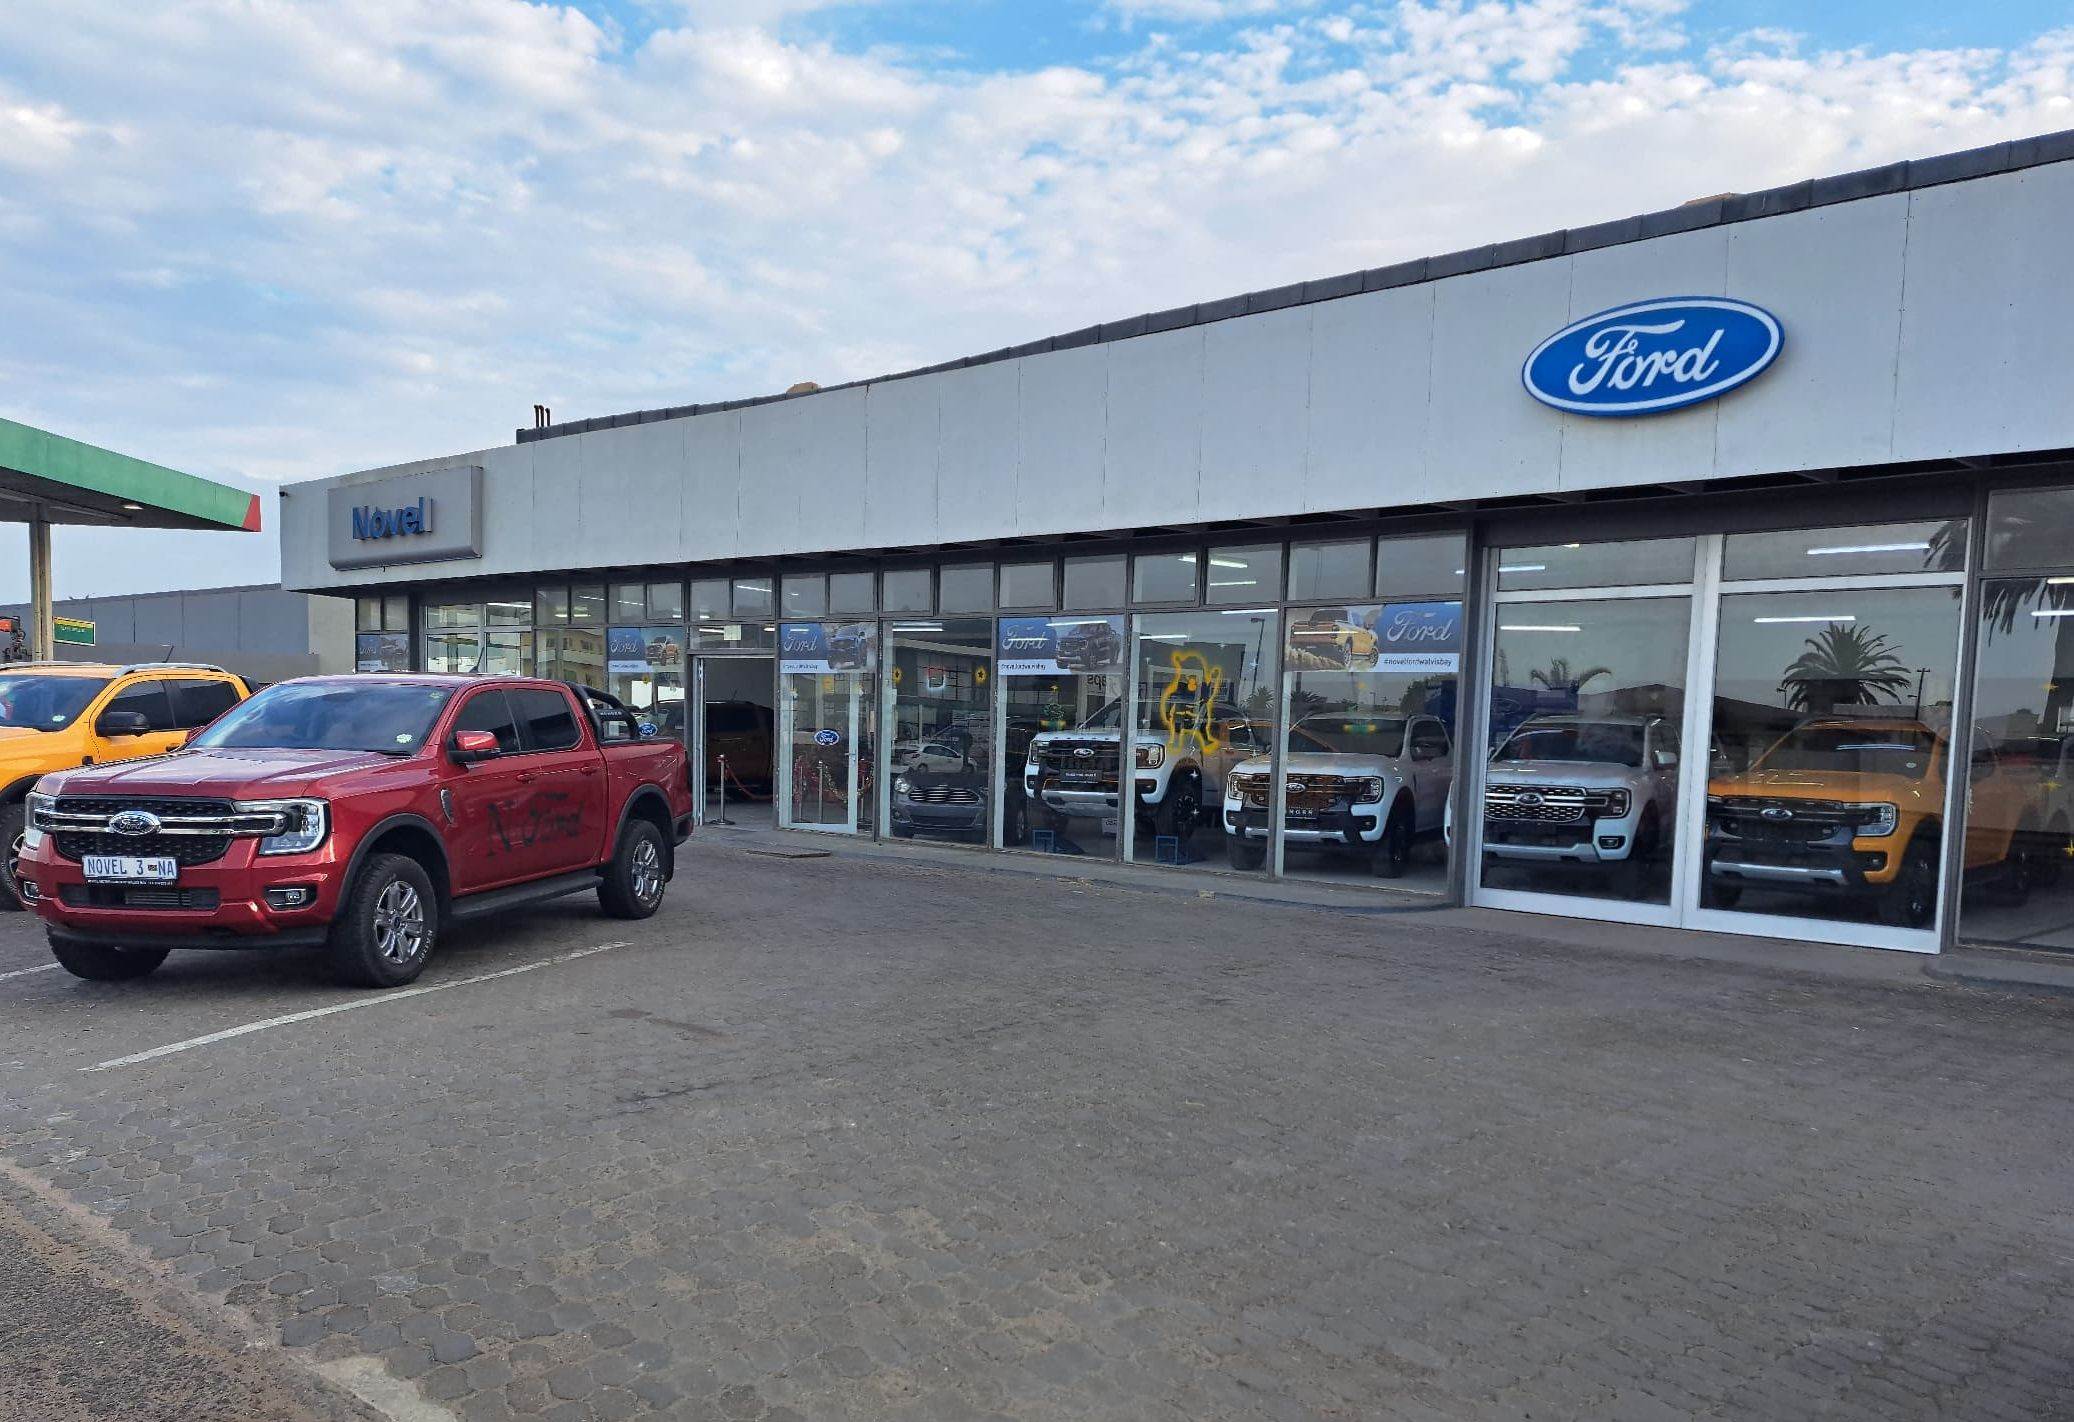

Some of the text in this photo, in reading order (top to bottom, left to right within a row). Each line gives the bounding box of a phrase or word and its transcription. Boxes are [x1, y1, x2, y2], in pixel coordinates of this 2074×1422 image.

[1568, 319, 1725, 396] Ford
[352, 496, 430, 540] Novel
[1002, 624, 1048, 650] Ford
[1387, 610, 1454, 642] Ford
[783, 630, 818, 652] Ford
[87, 858, 175, 877] NOVEL 3 NA
